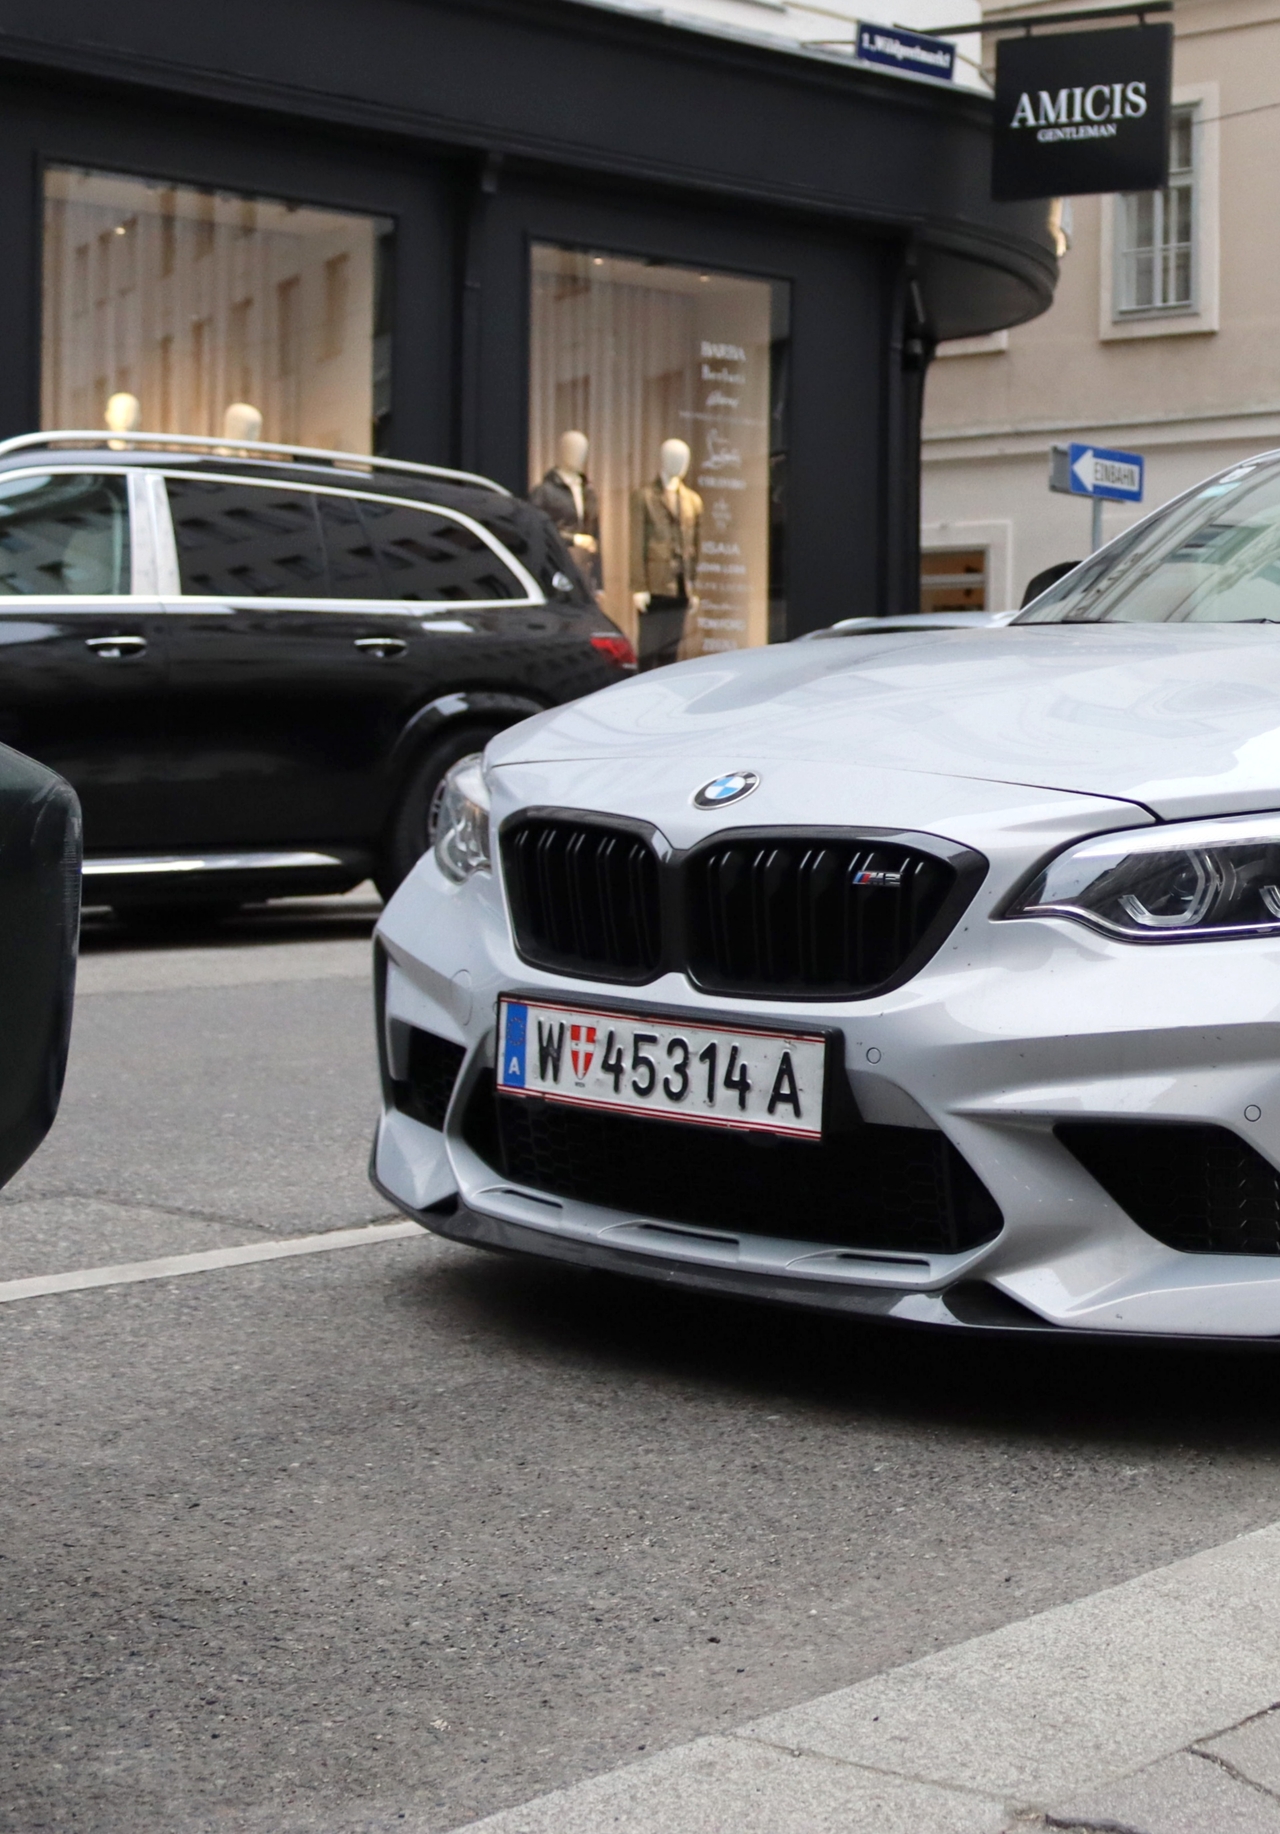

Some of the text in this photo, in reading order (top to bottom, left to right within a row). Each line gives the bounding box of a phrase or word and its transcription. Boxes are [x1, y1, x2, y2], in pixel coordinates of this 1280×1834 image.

[1010, 81, 1147, 128] AMICIS
[1036, 123, 1117, 143] GENTLEMAN
[1094, 461, 1136, 487] EINBAHN
[508, 1059, 520, 1076] A
[536, 1017, 803, 1119] W 45314 A
